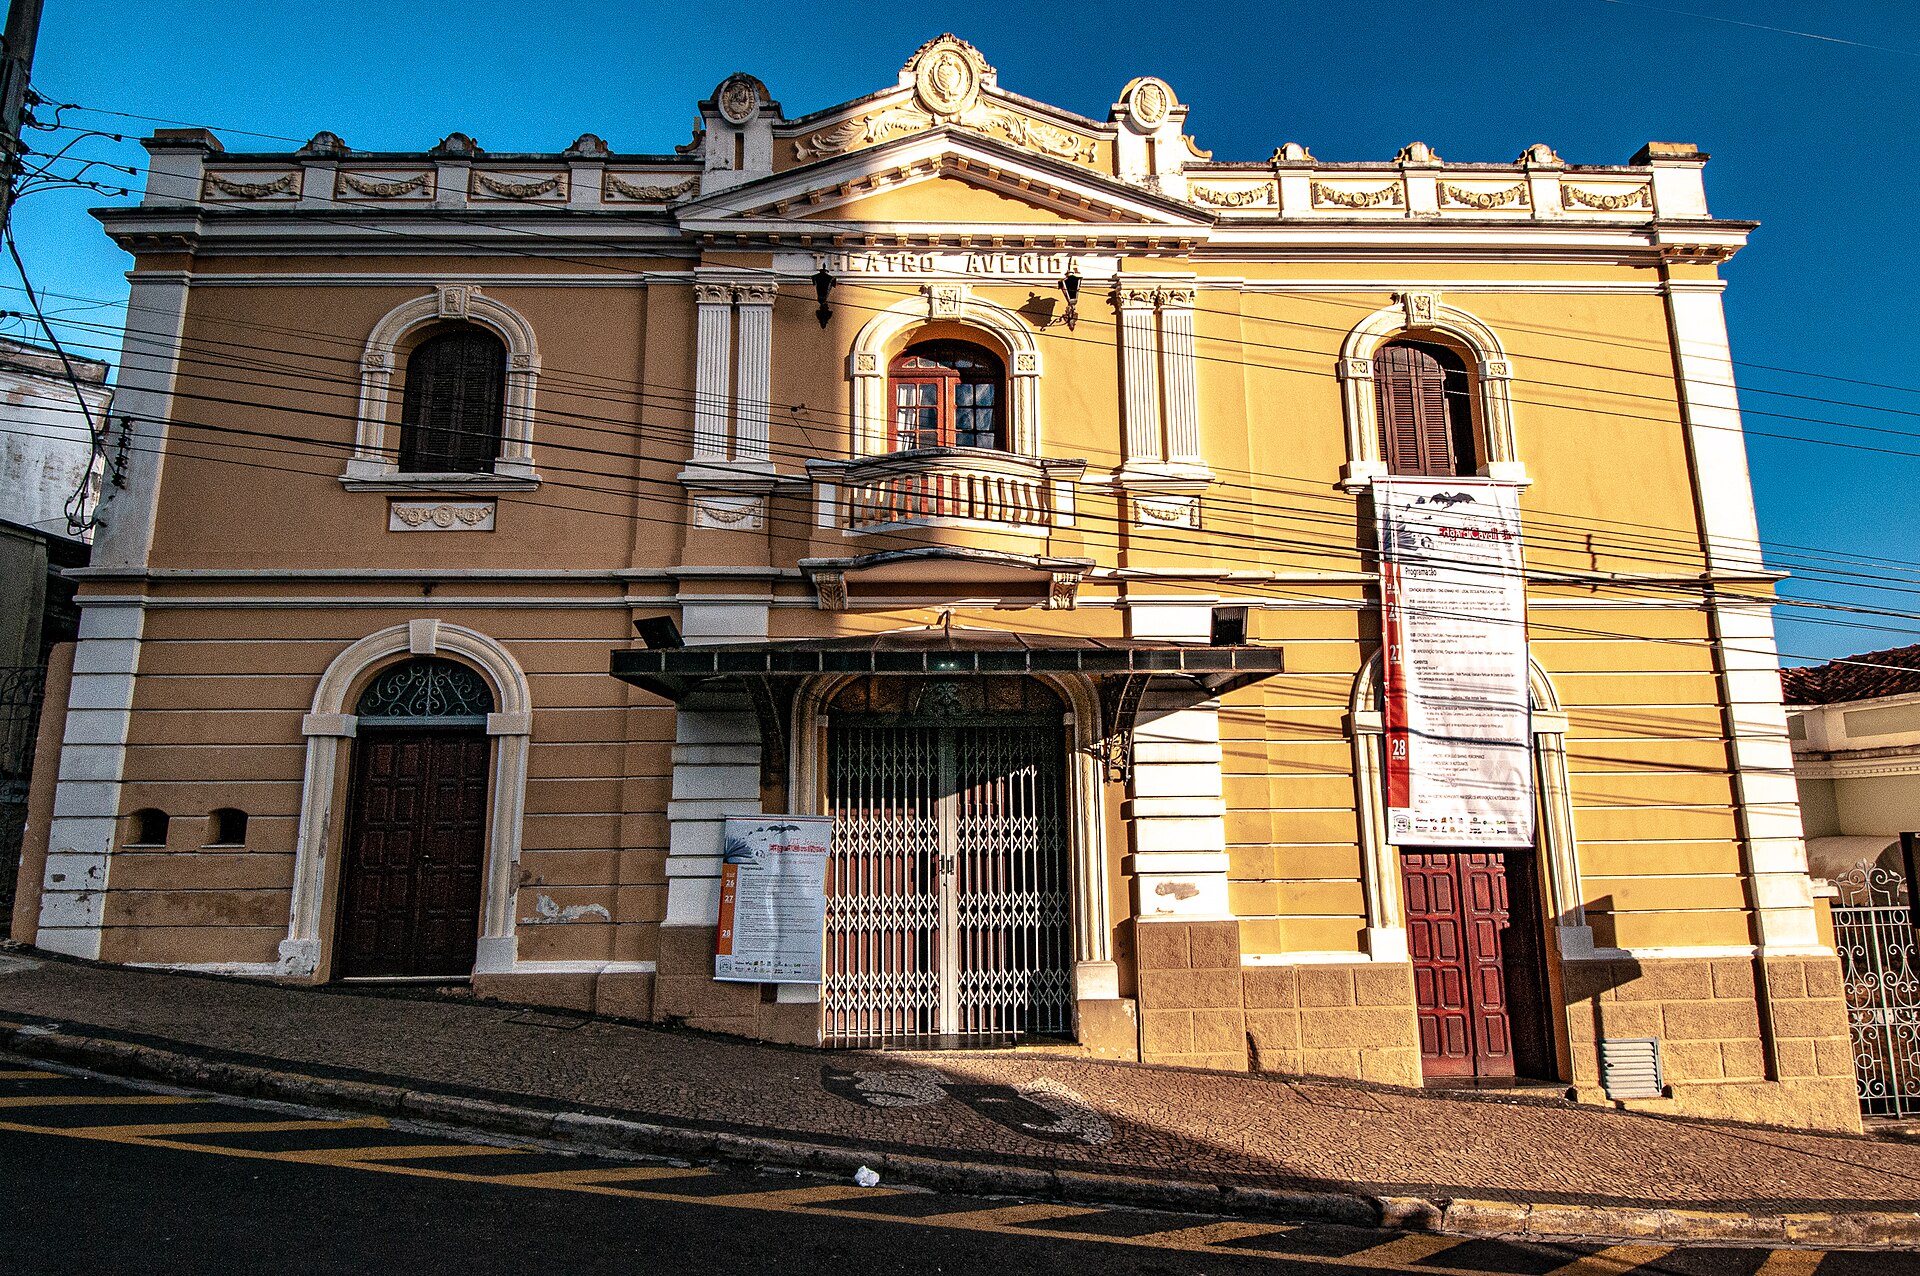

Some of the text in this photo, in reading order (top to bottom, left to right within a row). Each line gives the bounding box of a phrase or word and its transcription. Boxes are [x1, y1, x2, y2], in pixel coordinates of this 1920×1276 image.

[812, 251, 1081, 275] THEATRO AVENIDA
[1392, 739, 1406, 755] 28
[725, 895, 734, 903] 27
